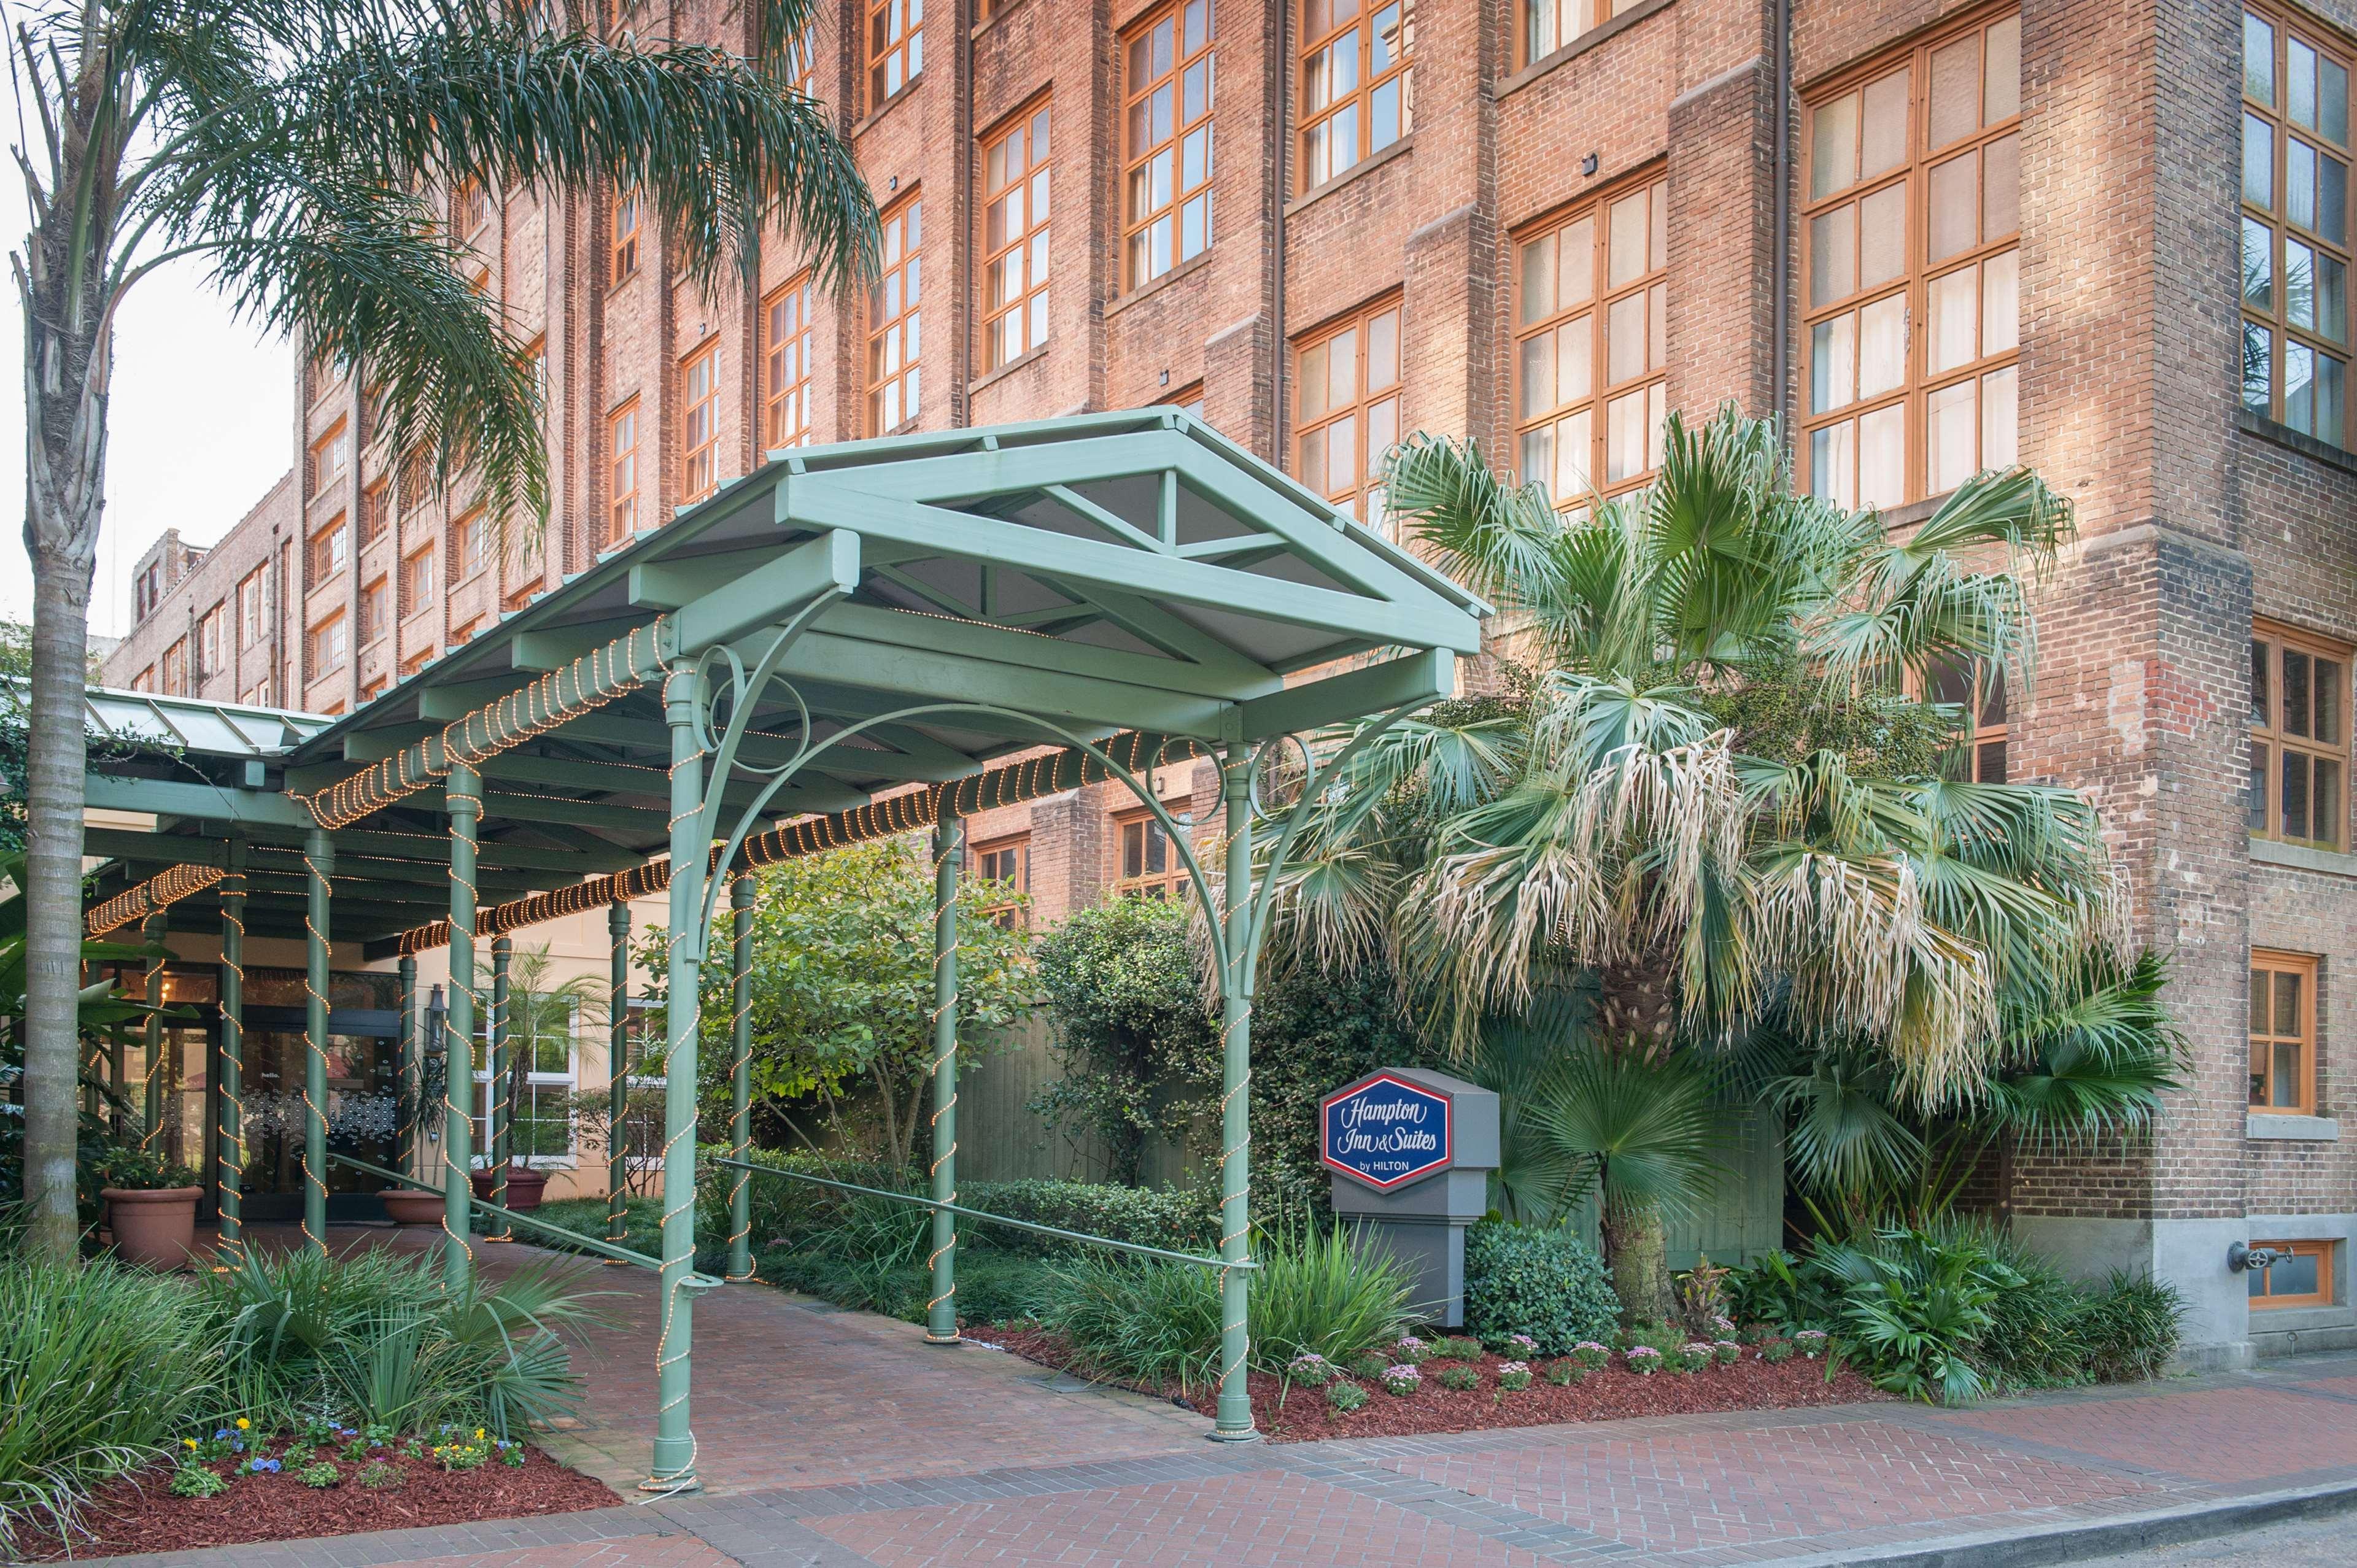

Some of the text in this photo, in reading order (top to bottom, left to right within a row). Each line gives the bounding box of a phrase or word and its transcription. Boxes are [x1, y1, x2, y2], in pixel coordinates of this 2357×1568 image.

[1341, 1096, 1427, 1128] Hampton
[1337, 1127, 1436, 1154] Inn & Suites
[1360, 1161, 1409, 1172] by HILTON
